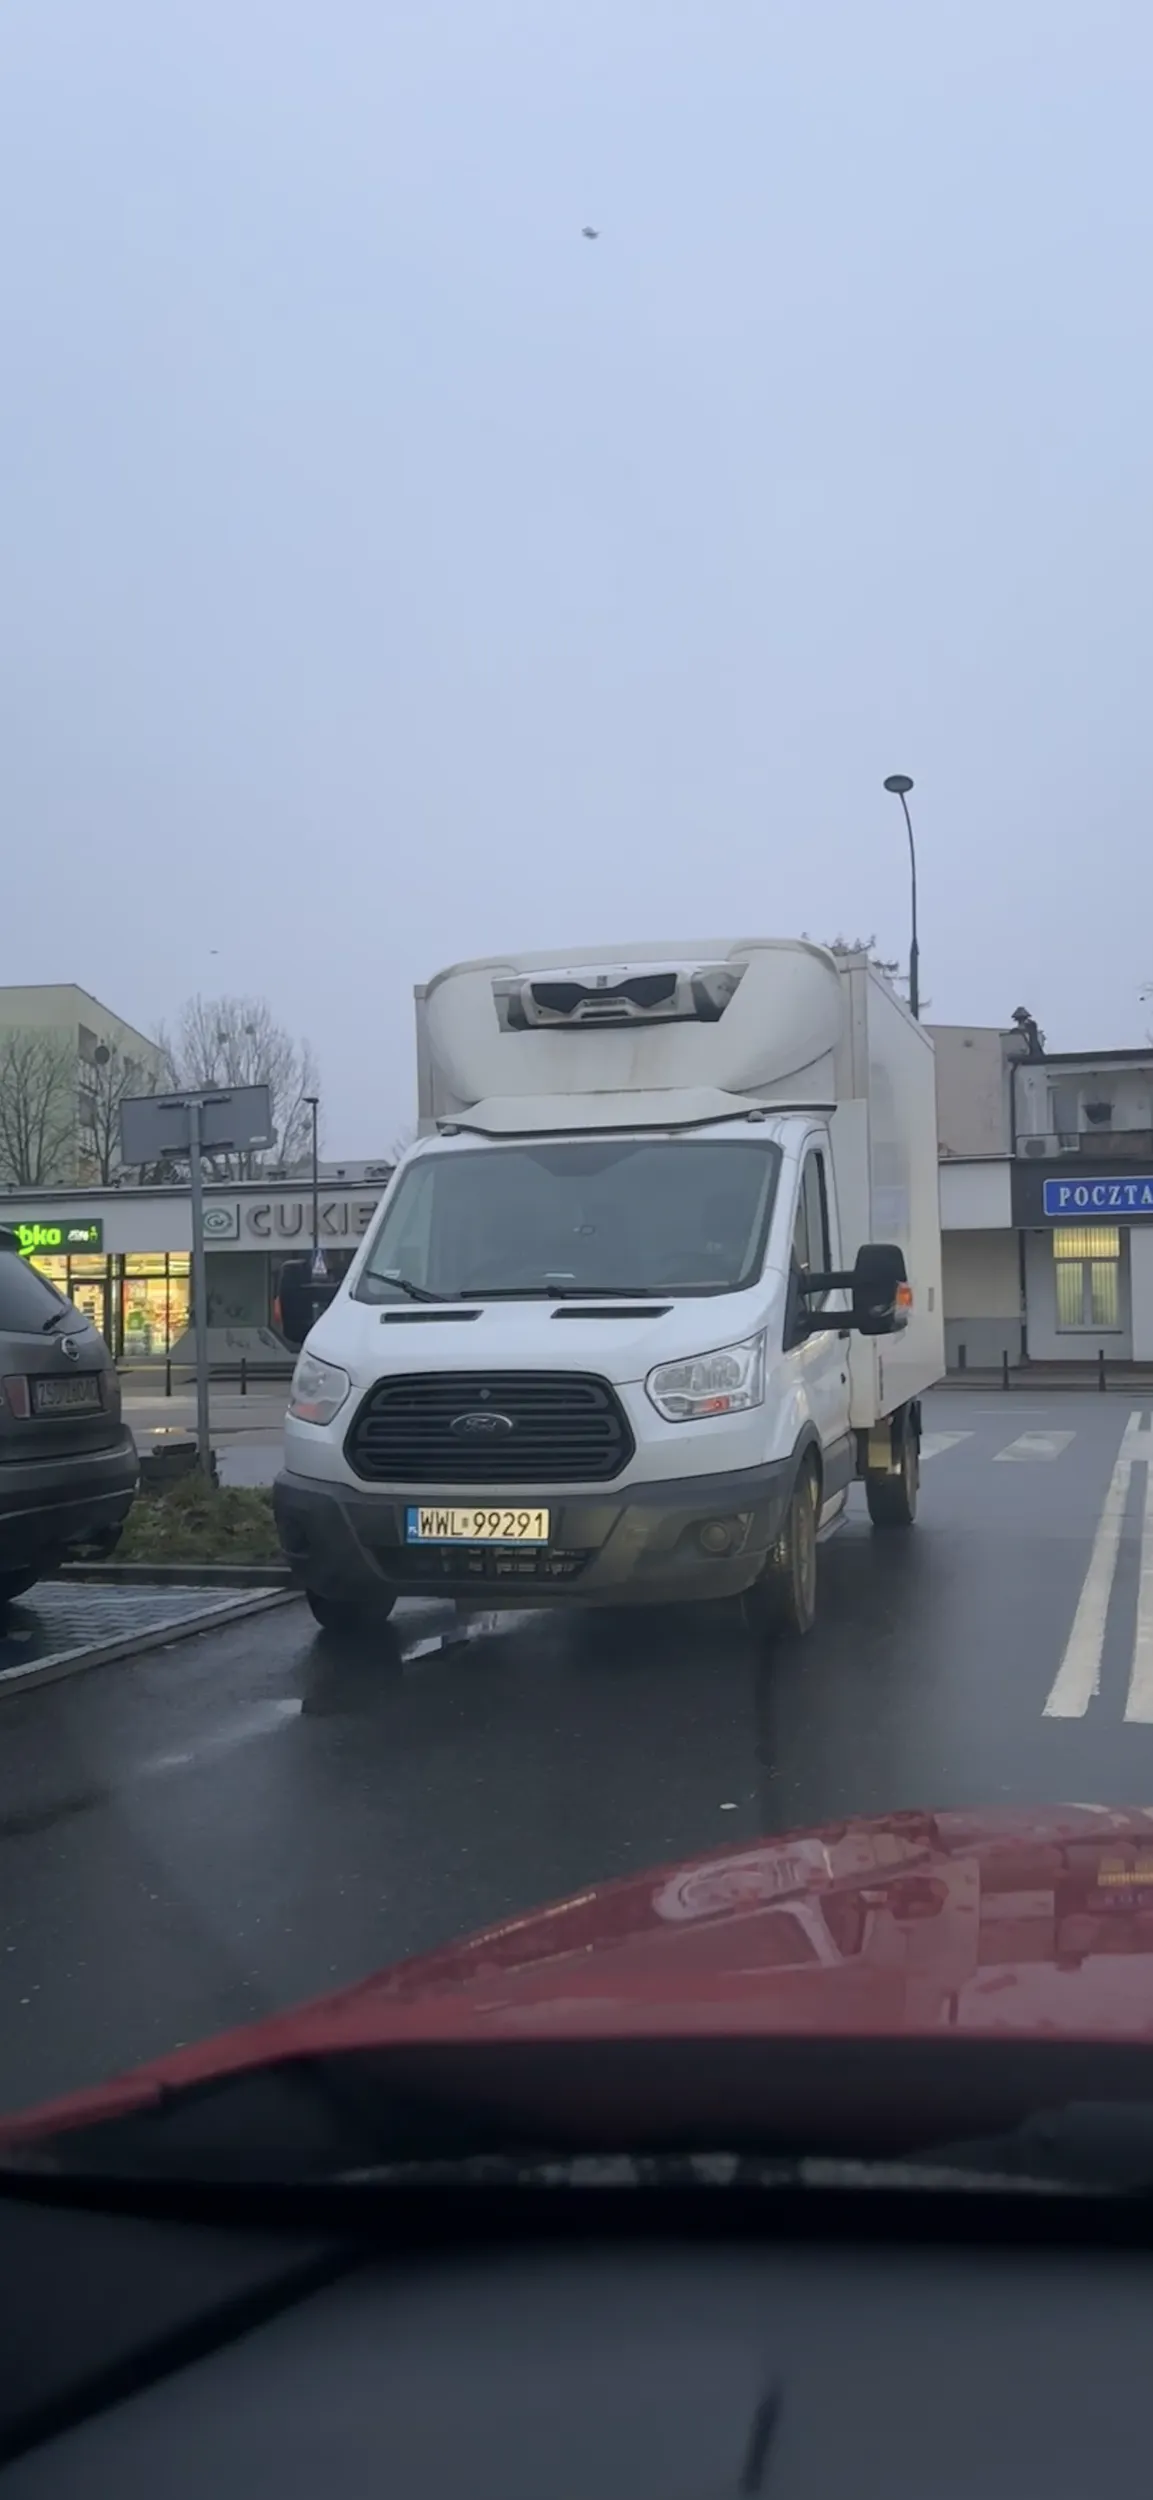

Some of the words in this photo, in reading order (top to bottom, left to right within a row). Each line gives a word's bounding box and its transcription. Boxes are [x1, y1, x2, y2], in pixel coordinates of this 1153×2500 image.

[1059, 1185, 1153, 1207] POCZTA
[14, 1224, 61, 1246] bka
[420, 1511, 463, 1536] WWL
[473, 1511, 543, 1537] 99291
